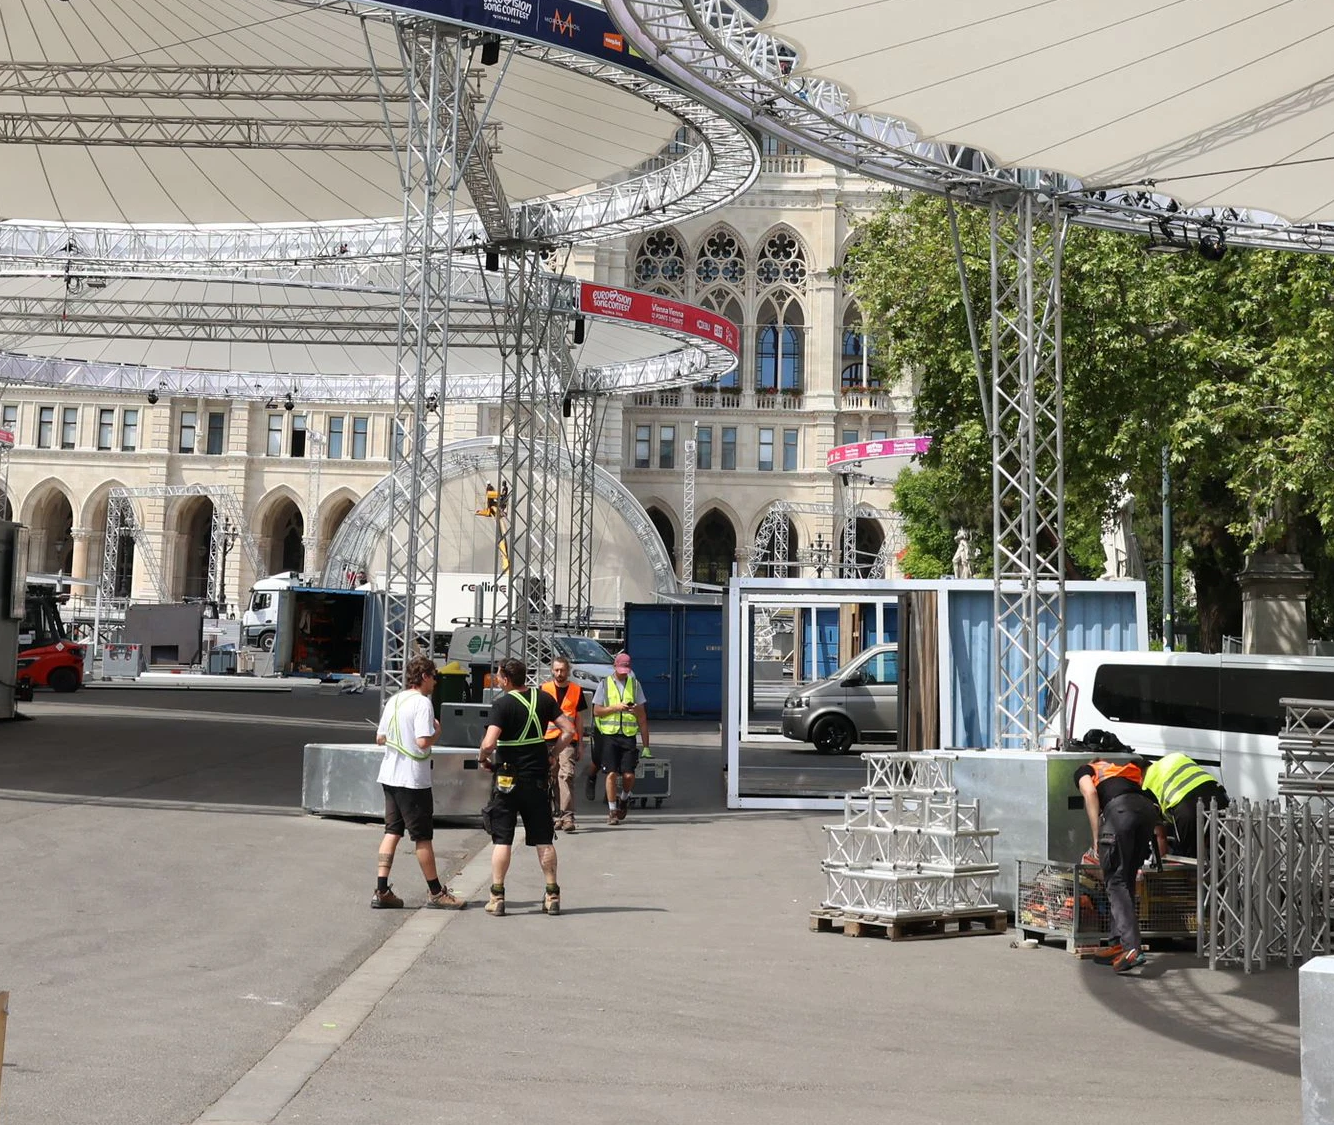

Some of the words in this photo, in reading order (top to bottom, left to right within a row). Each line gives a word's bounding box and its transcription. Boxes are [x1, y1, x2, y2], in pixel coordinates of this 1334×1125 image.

[483, 2, 501, 12] SONG
[502, 5, 529, 20] CONTEST
[652, 304, 668, 314] Vienna
[668, 307, 684, 318] Vienna
